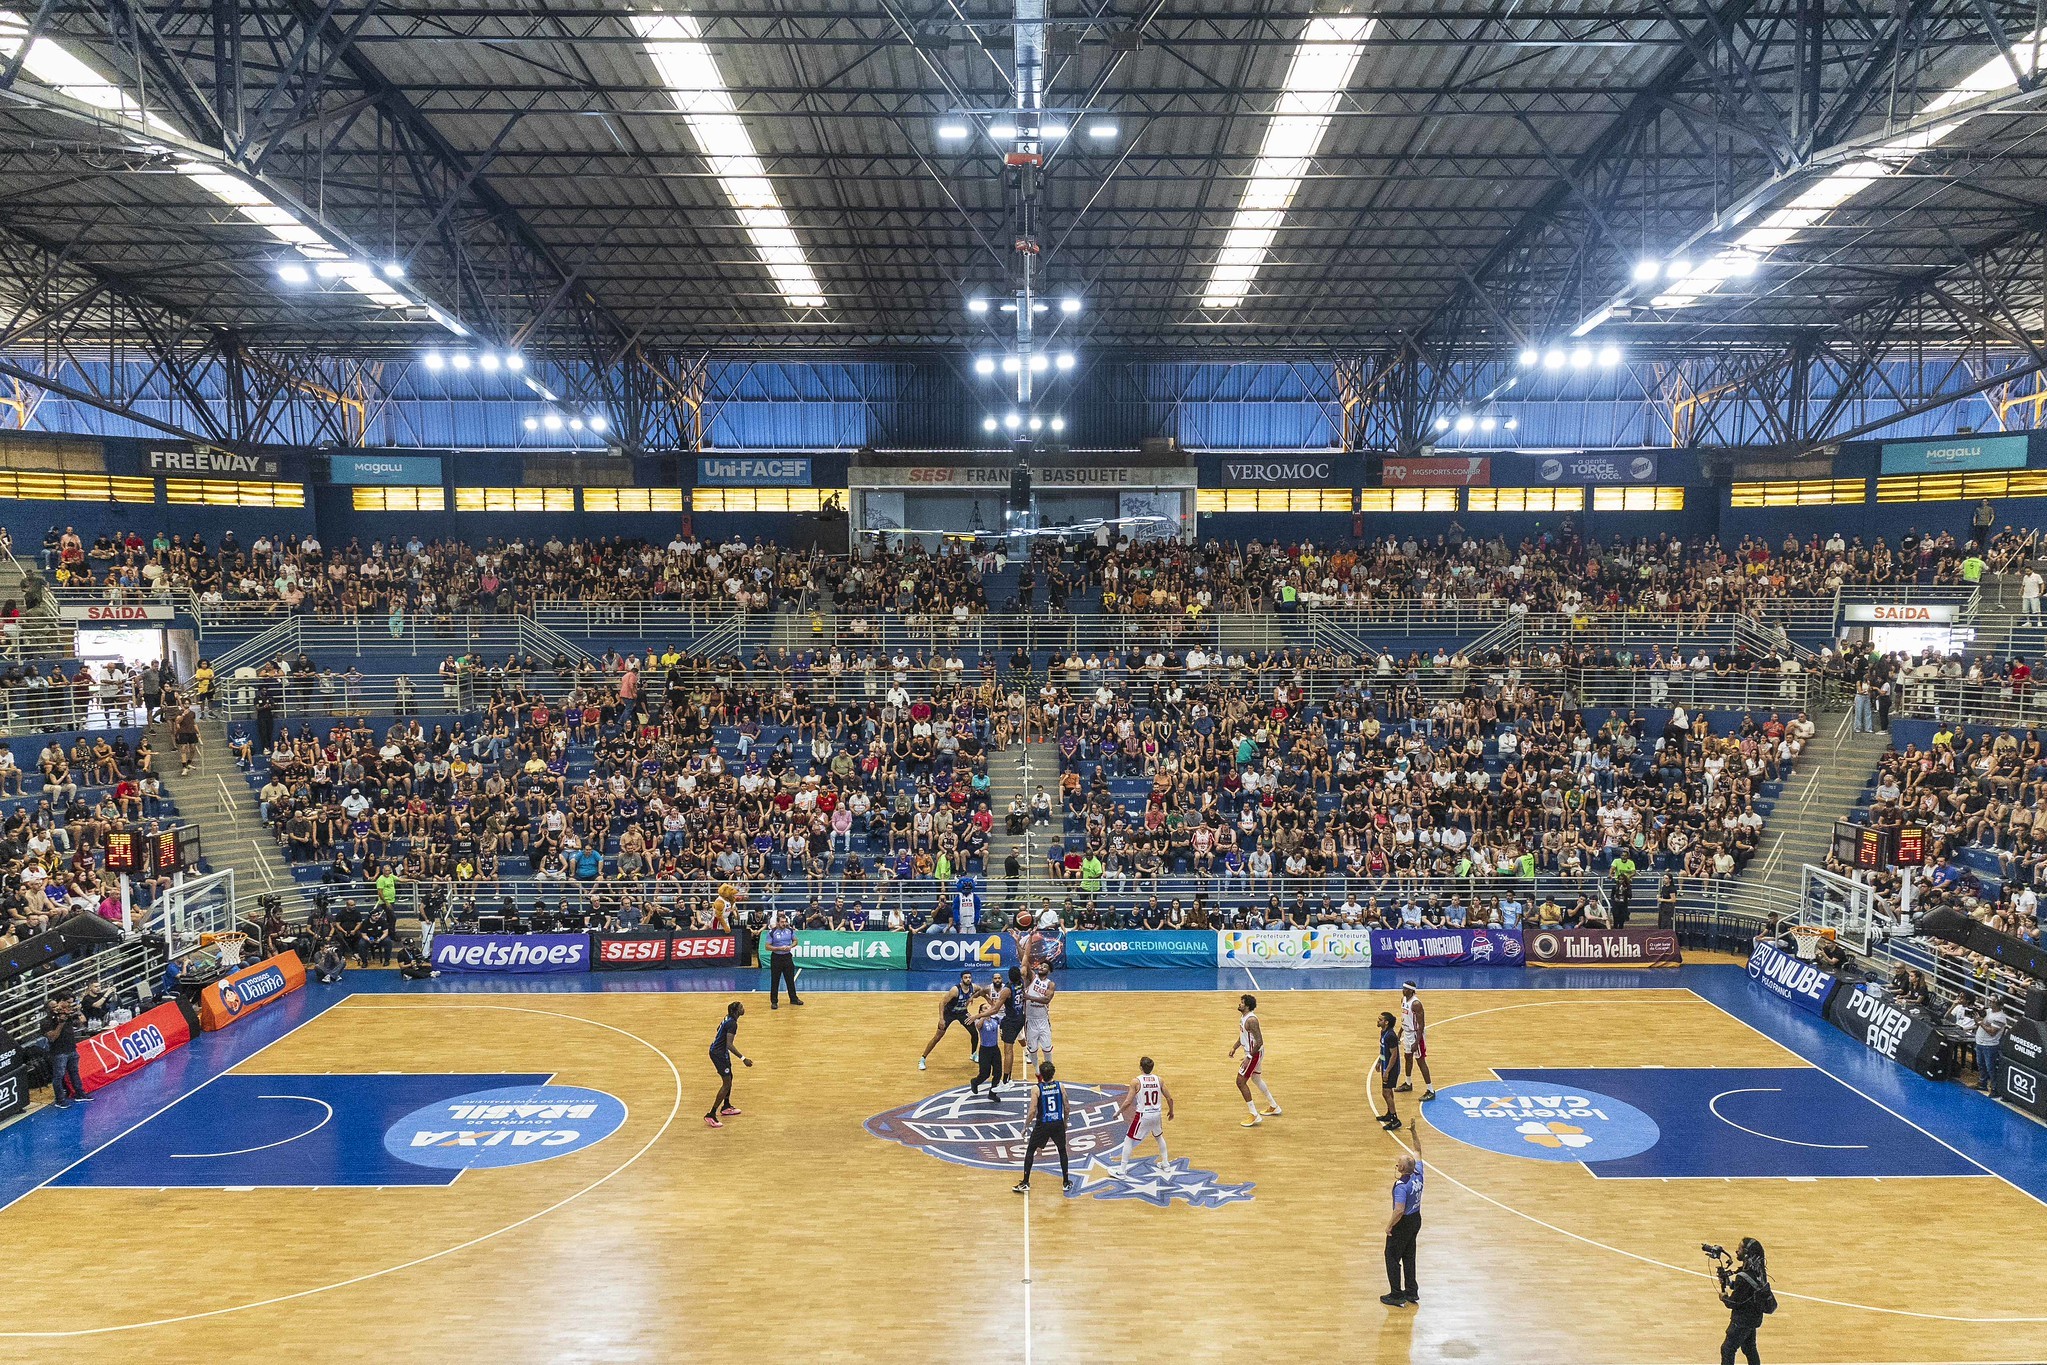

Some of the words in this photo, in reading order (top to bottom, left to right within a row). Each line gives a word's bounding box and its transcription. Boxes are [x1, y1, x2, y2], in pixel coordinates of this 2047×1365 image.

[150, 451, 260, 472] FREEWAY
[704, 460, 807, 478] Uni-FACEF
[908, 468, 954, 482] SESI
[1042, 468, 1128, 482] BASQUETE
[1227, 463, 1329, 481] VEROMOC
[606, 942, 660, 960] SESI
[675, 938, 729, 956] SESI
[791, 940, 859, 958] nimed
[1380, 937, 1393, 951] SEJA
[1394, 935, 1464, 959] SÓCIO-TORCEDOR
[1764, 950, 1830, 1000] UNIUBE
[238, 973, 284, 1002] Daiana
[1846, 988, 1912, 1040] POWER
[1866, 1024, 1900, 1060] ADE
[2010, 1034, 2042, 1053] INGRESSOS
[2014, 1044, 2036, 1058] ONLINE
[2014, 1074, 2028, 1091] Q2
[1048, 1096, 1056, 1112] 5
[1144, 1090, 1159, 1106] 10
[1450, 1096, 1591, 1108] CAIXA
[448, 1104, 599, 1120] BRASIL
[1464, 1108, 1610, 1122] loterias
[409, 1130, 580, 1147] CAIXA
